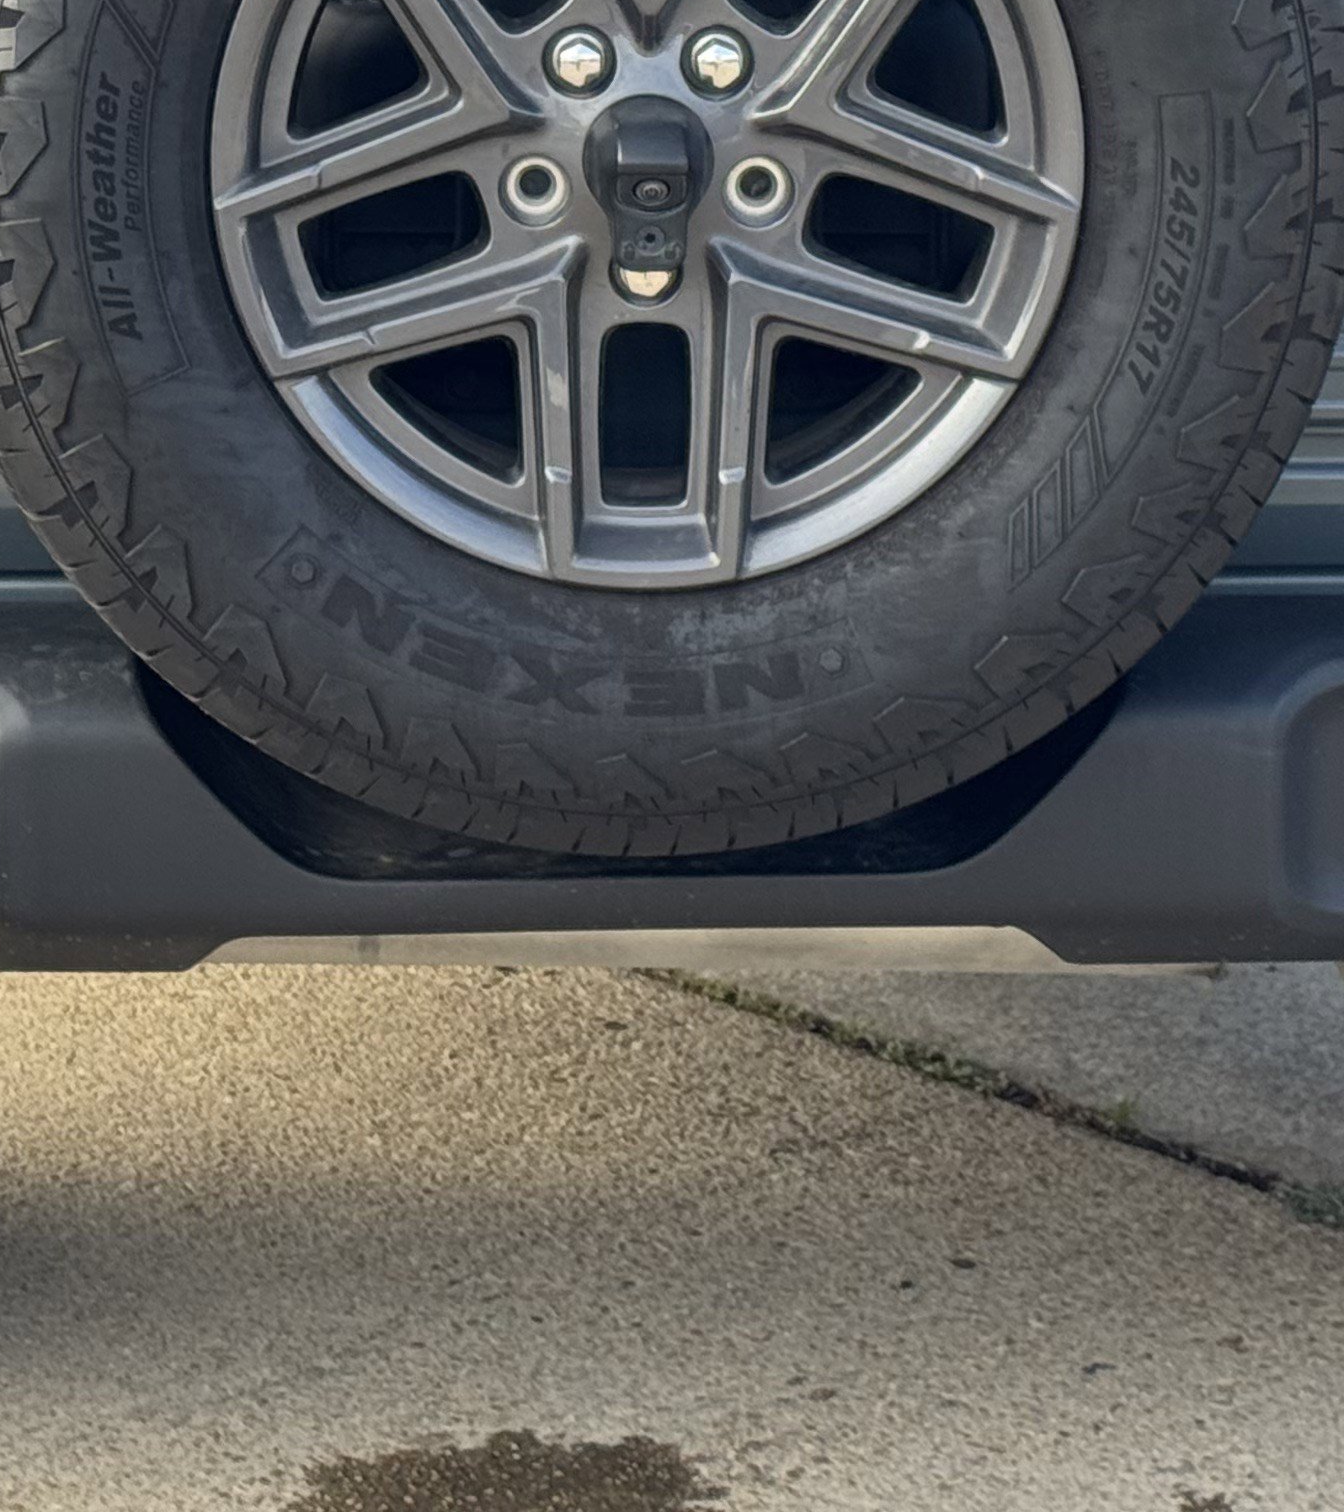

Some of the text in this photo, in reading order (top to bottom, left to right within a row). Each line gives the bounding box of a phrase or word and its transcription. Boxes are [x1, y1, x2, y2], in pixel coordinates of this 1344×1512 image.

[86, 71, 143, 341] All-Weather
[121, 79, 147, 233] Performance
[1128, 155, 1202, 395] 245/75R17
[320, 572, 805, 717] NEXEN
